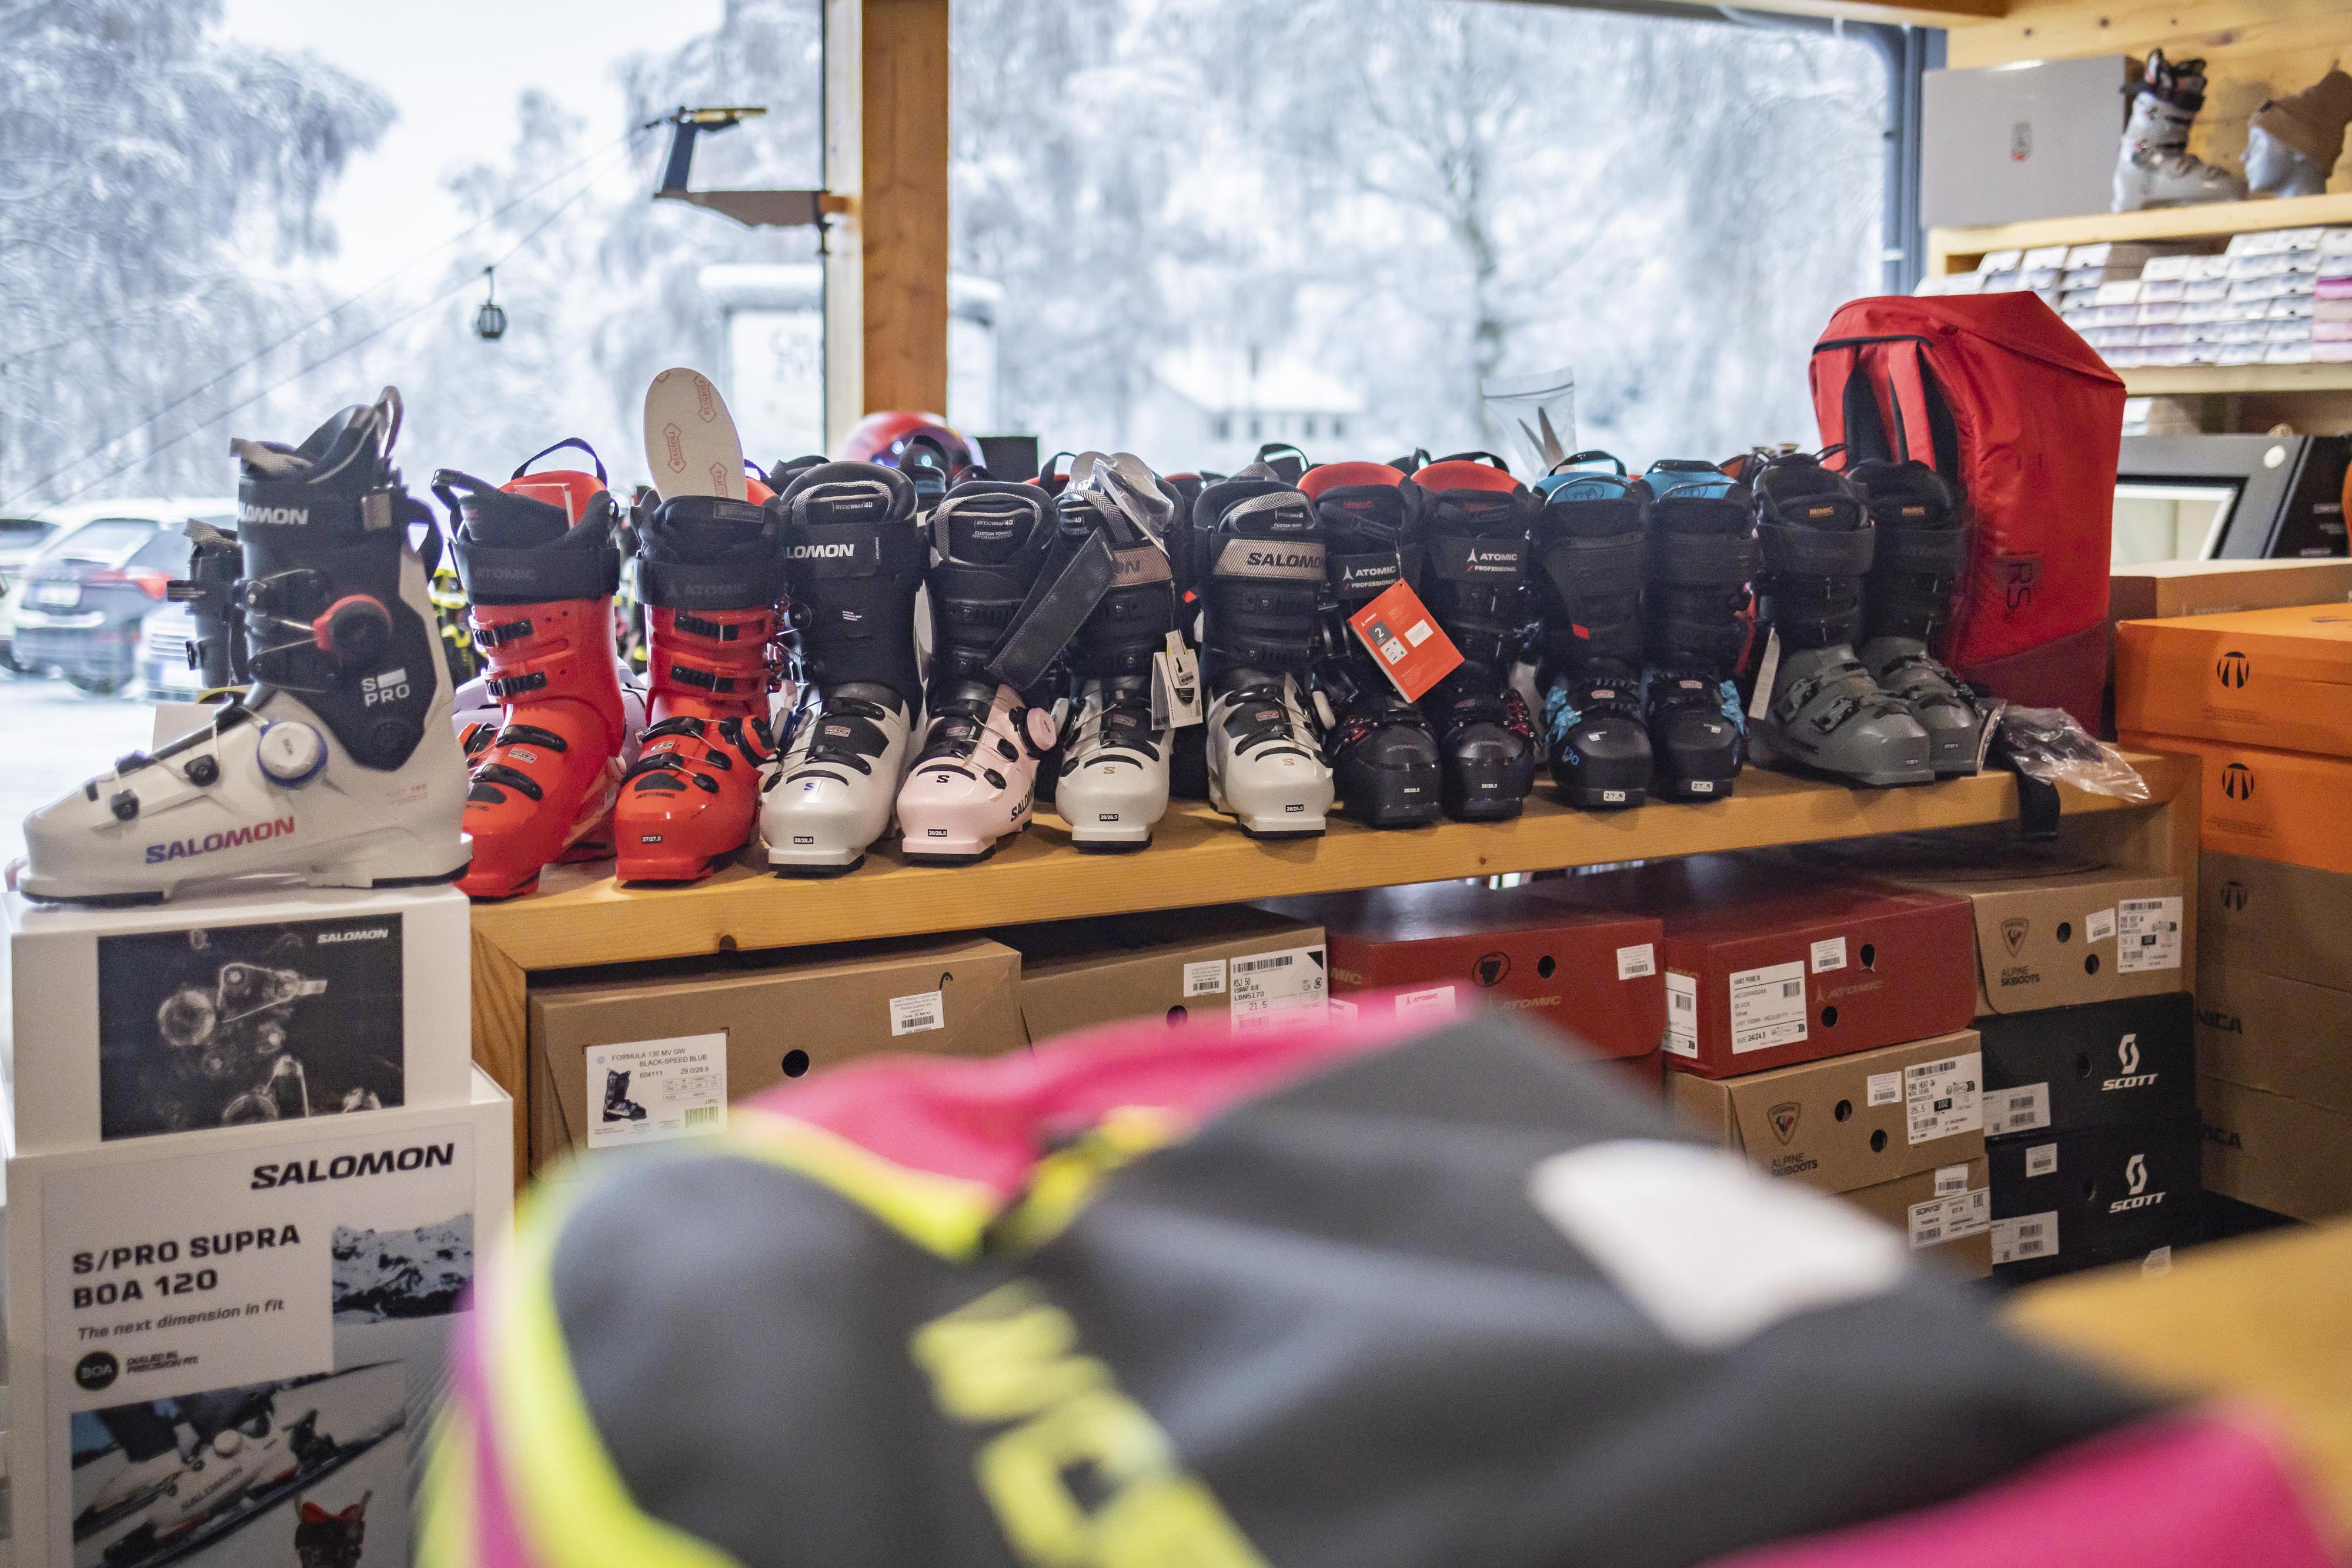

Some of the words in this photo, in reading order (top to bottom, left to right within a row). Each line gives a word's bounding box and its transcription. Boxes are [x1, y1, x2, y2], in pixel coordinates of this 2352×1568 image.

[1809, 507, 1833, 515] MIMIC
[1355, 566, 1396, 577] ATOMIC
[1374, 627, 1385, 638] 2
[361, 677, 376, 691] S
[365, 684, 410, 706] PRO
[145, 816, 295, 864] SALOMON
[318, 929, 388, 944] SALOMON
[2001, 974, 2040, 987] SKIBOOTS
[1234, 991, 1265, 1001] LBN5170
[1414, 992, 1439, 1002] ATOMIC
[1501, 995, 1562, 1009] ATOMIC
[1249, 1001, 1267, 1011] 21.5
[1748, 1032, 1766, 1042] 24/24.5
[612, 1052, 646, 1061] FORMULA
[639, 1057, 689, 1067] BLACK-SPEED
[639, 1070, 663, 1078] 604111
[680, 1066, 710, 1075] 29.0/29.5
[2102, 1074, 2159, 1091] SCOTT
[1911, 1105, 1926, 1115] 25.5
[250, 1142, 455, 1190] SALOMON
[1772, 1153, 1804, 1167] ALPINE
[2109, 1192, 2166, 1213] SCOTT
[72, 1241, 179, 1275] S/PRO
[189, 1225, 300, 1259] SUPRA
[74, 1279, 143, 1310] BOA
[155, 1268, 218, 1296] 120
[78, 1326, 109, 1340] The
[114, 1319, 153, 1336] next
[157, 1306, 240, 1329] dimension
[245, 1301, 259, 1315] in
[81, 1363, 114, 1379] BOA
